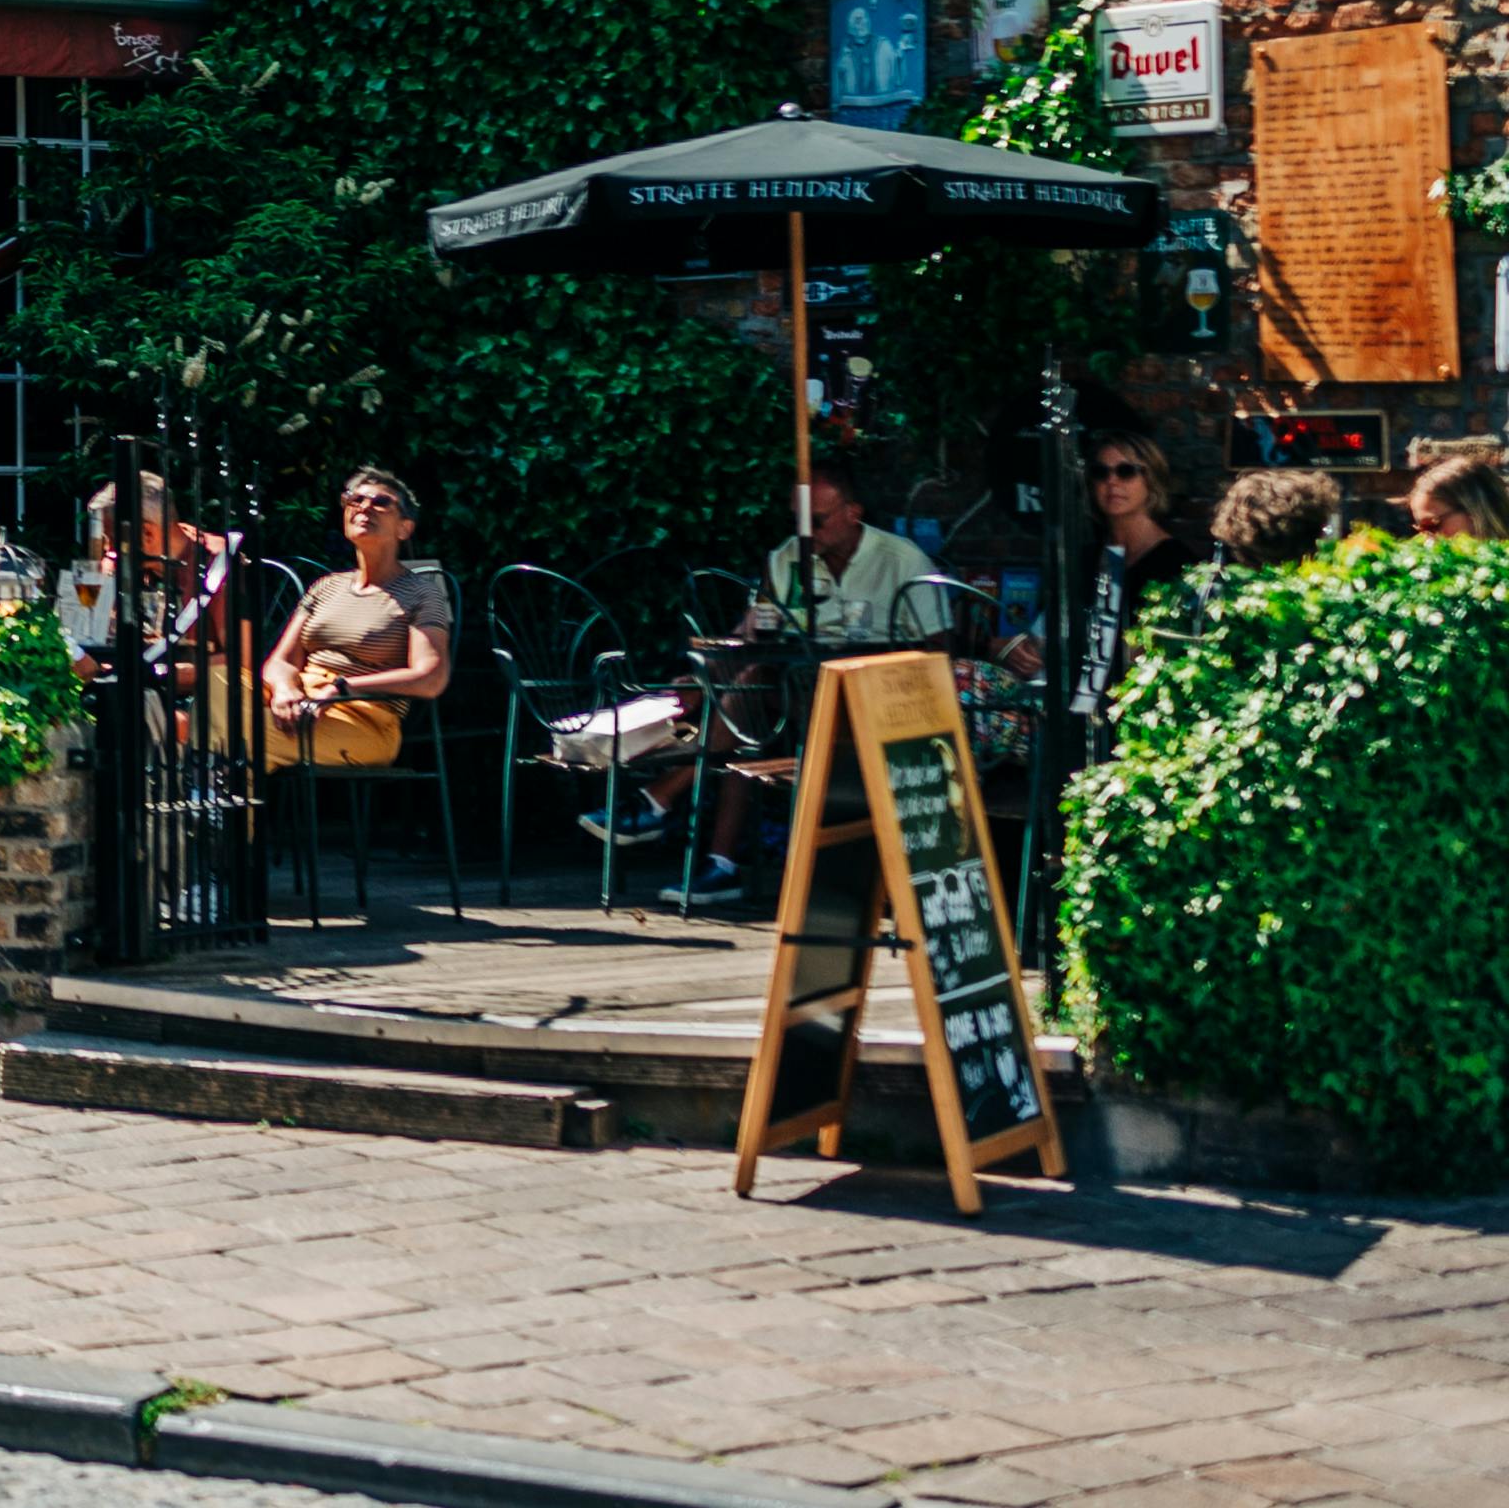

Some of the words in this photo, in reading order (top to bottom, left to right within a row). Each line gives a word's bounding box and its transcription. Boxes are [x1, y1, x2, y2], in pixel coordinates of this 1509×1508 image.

[1110, 37, 1199, 80] Duvel
[629, 180, 738, 205] STRAFFE
[943, 181, 1029, 202] STRAFFE
